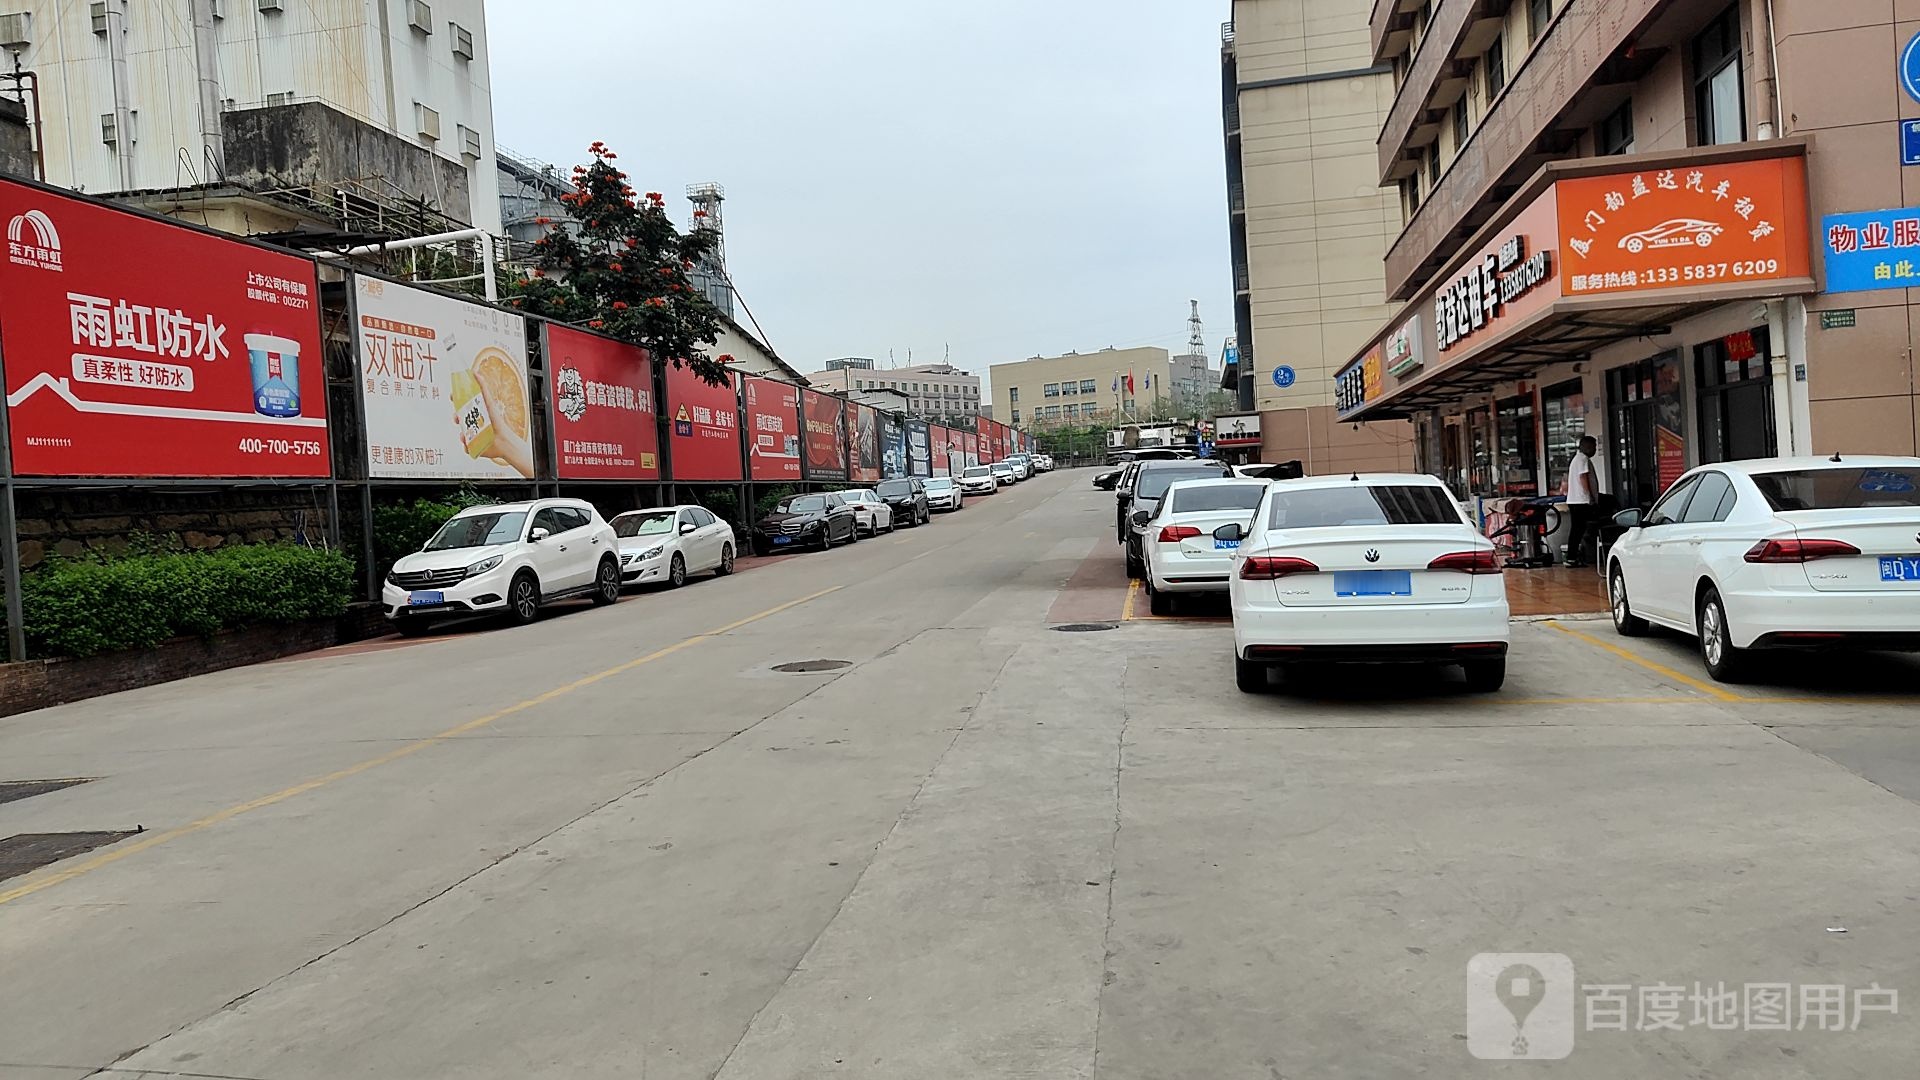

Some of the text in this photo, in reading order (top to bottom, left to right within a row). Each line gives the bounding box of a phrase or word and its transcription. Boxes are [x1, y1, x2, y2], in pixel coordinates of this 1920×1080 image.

[8, 242, 62, 265] 东方雨虹
[1684, 263, 1728, 280] 5837
[1732, 259, 1778, 276] 6209
[1874, 260, 1920, 280] 由此
[246, 271, 308, 296] 上市公司有保障
[66, 291, 230, 361] 雨虹防水
[365, 333, 438, 383] 双柚汁
[82, 357, 186, 387] 真柔性 好防水
[366, 378, 441, 400] 复合果汁饮料
[238, 438, 321, 456] 400-700-5756
[371, 445, 444, 466] 更健康的双柚汁
